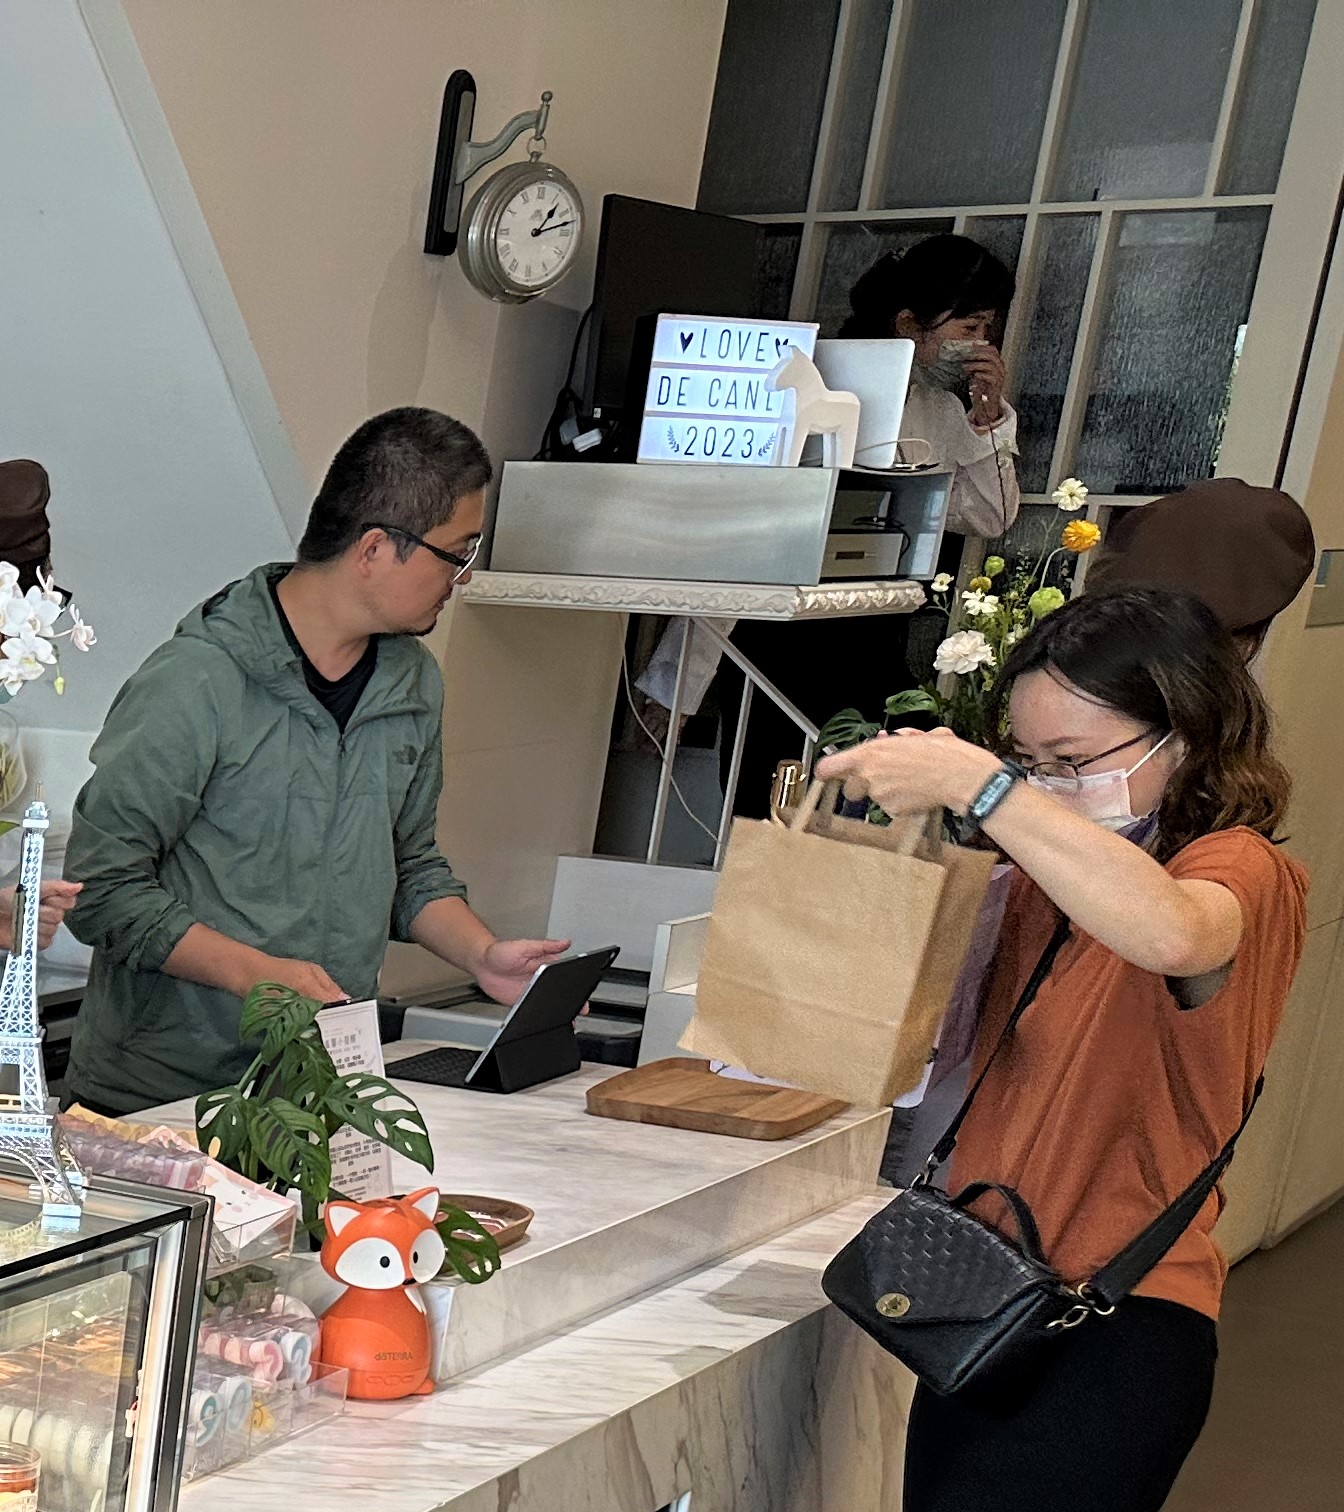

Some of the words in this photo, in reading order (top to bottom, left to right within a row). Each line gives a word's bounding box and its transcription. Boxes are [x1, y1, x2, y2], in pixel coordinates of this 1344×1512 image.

[700, 328, 770, 362] LOVE
[657, 375, 691, 406] DE
[683, 426, 754, 459] 2023
